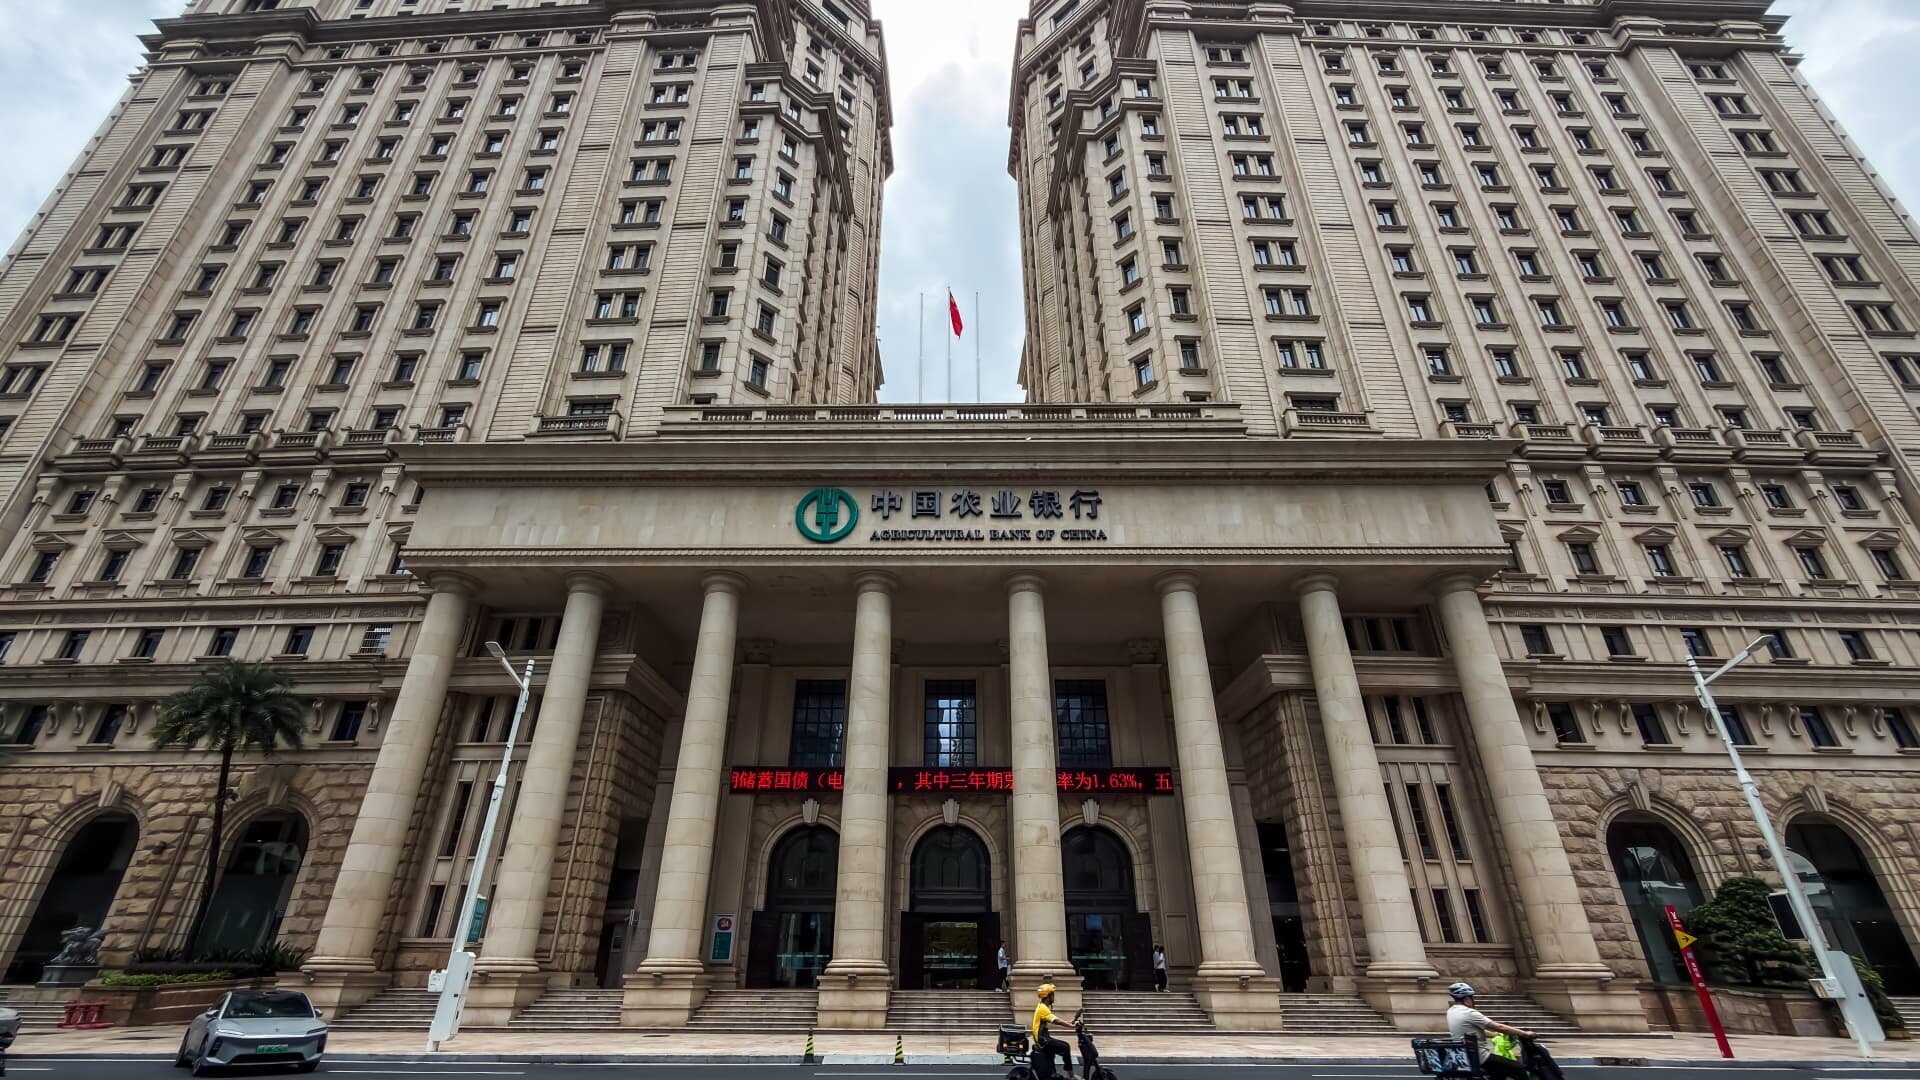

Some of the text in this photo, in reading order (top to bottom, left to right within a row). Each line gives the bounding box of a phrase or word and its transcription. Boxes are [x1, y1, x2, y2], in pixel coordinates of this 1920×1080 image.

[871, 488, 1103, 519] 中国农业银行
[869, 529, 1107, 541] AGRICULTURAL BANK OF CHINA
